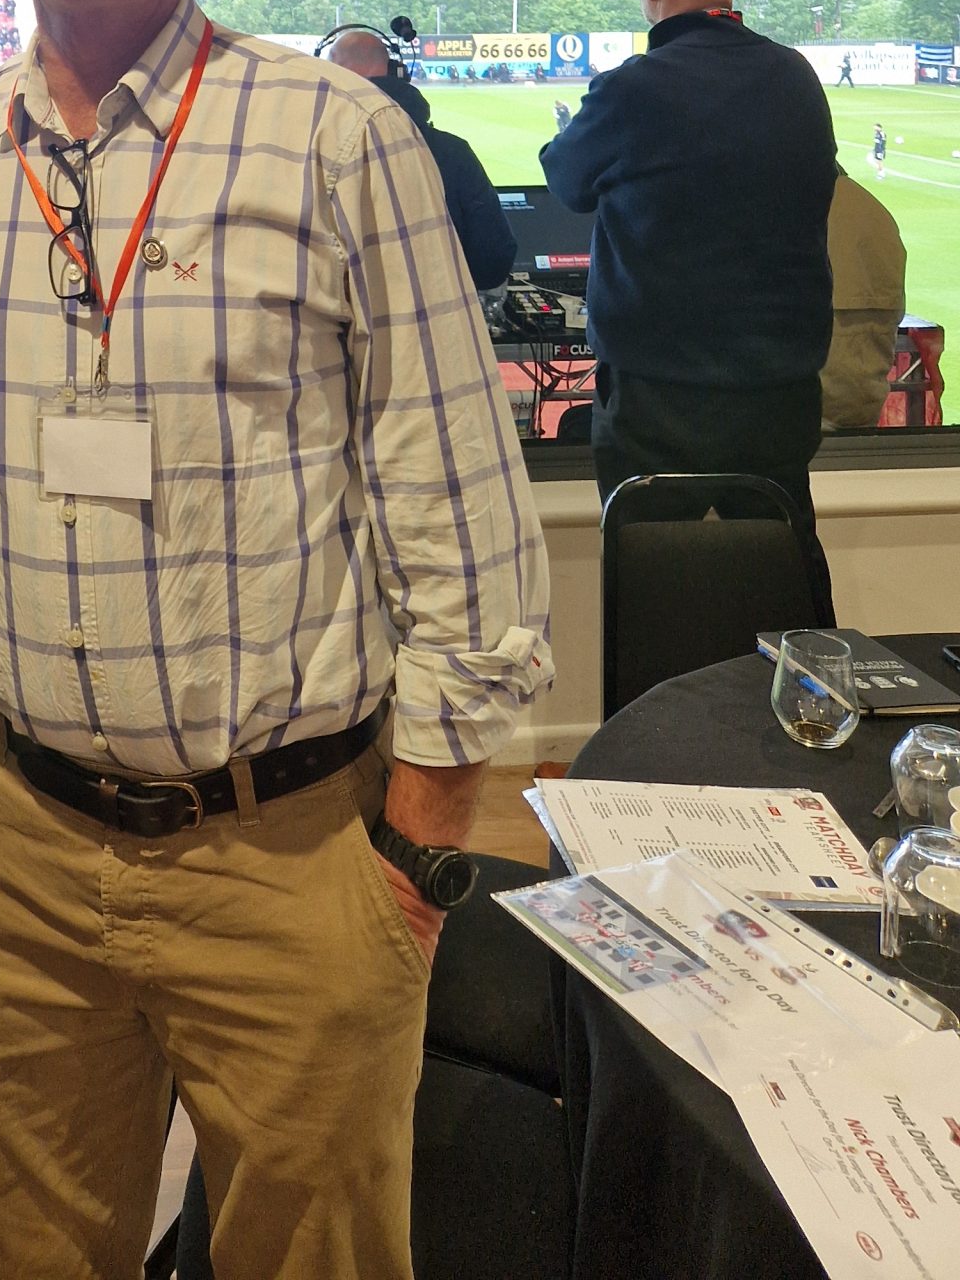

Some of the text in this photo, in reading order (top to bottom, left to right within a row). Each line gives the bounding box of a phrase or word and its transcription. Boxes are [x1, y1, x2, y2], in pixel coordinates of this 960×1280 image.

[436, 40, 474, 51] APPLE
[480, 43, 548, 58] 66 66 66
[554, 344, 594, 356] FOCUS
[810, 815, 872, 879] MATCHDAY
[655, 906, 798, 1014] Trust Director for a Day
[688, 974, 731, 1006] mbers
[883, 1094, 917, 1128] Trust
[907, 1128, 955, 1185] Director
[844, 1117, 875, 1148] Nick
[865, 1149, 920, 1220] Chambers
